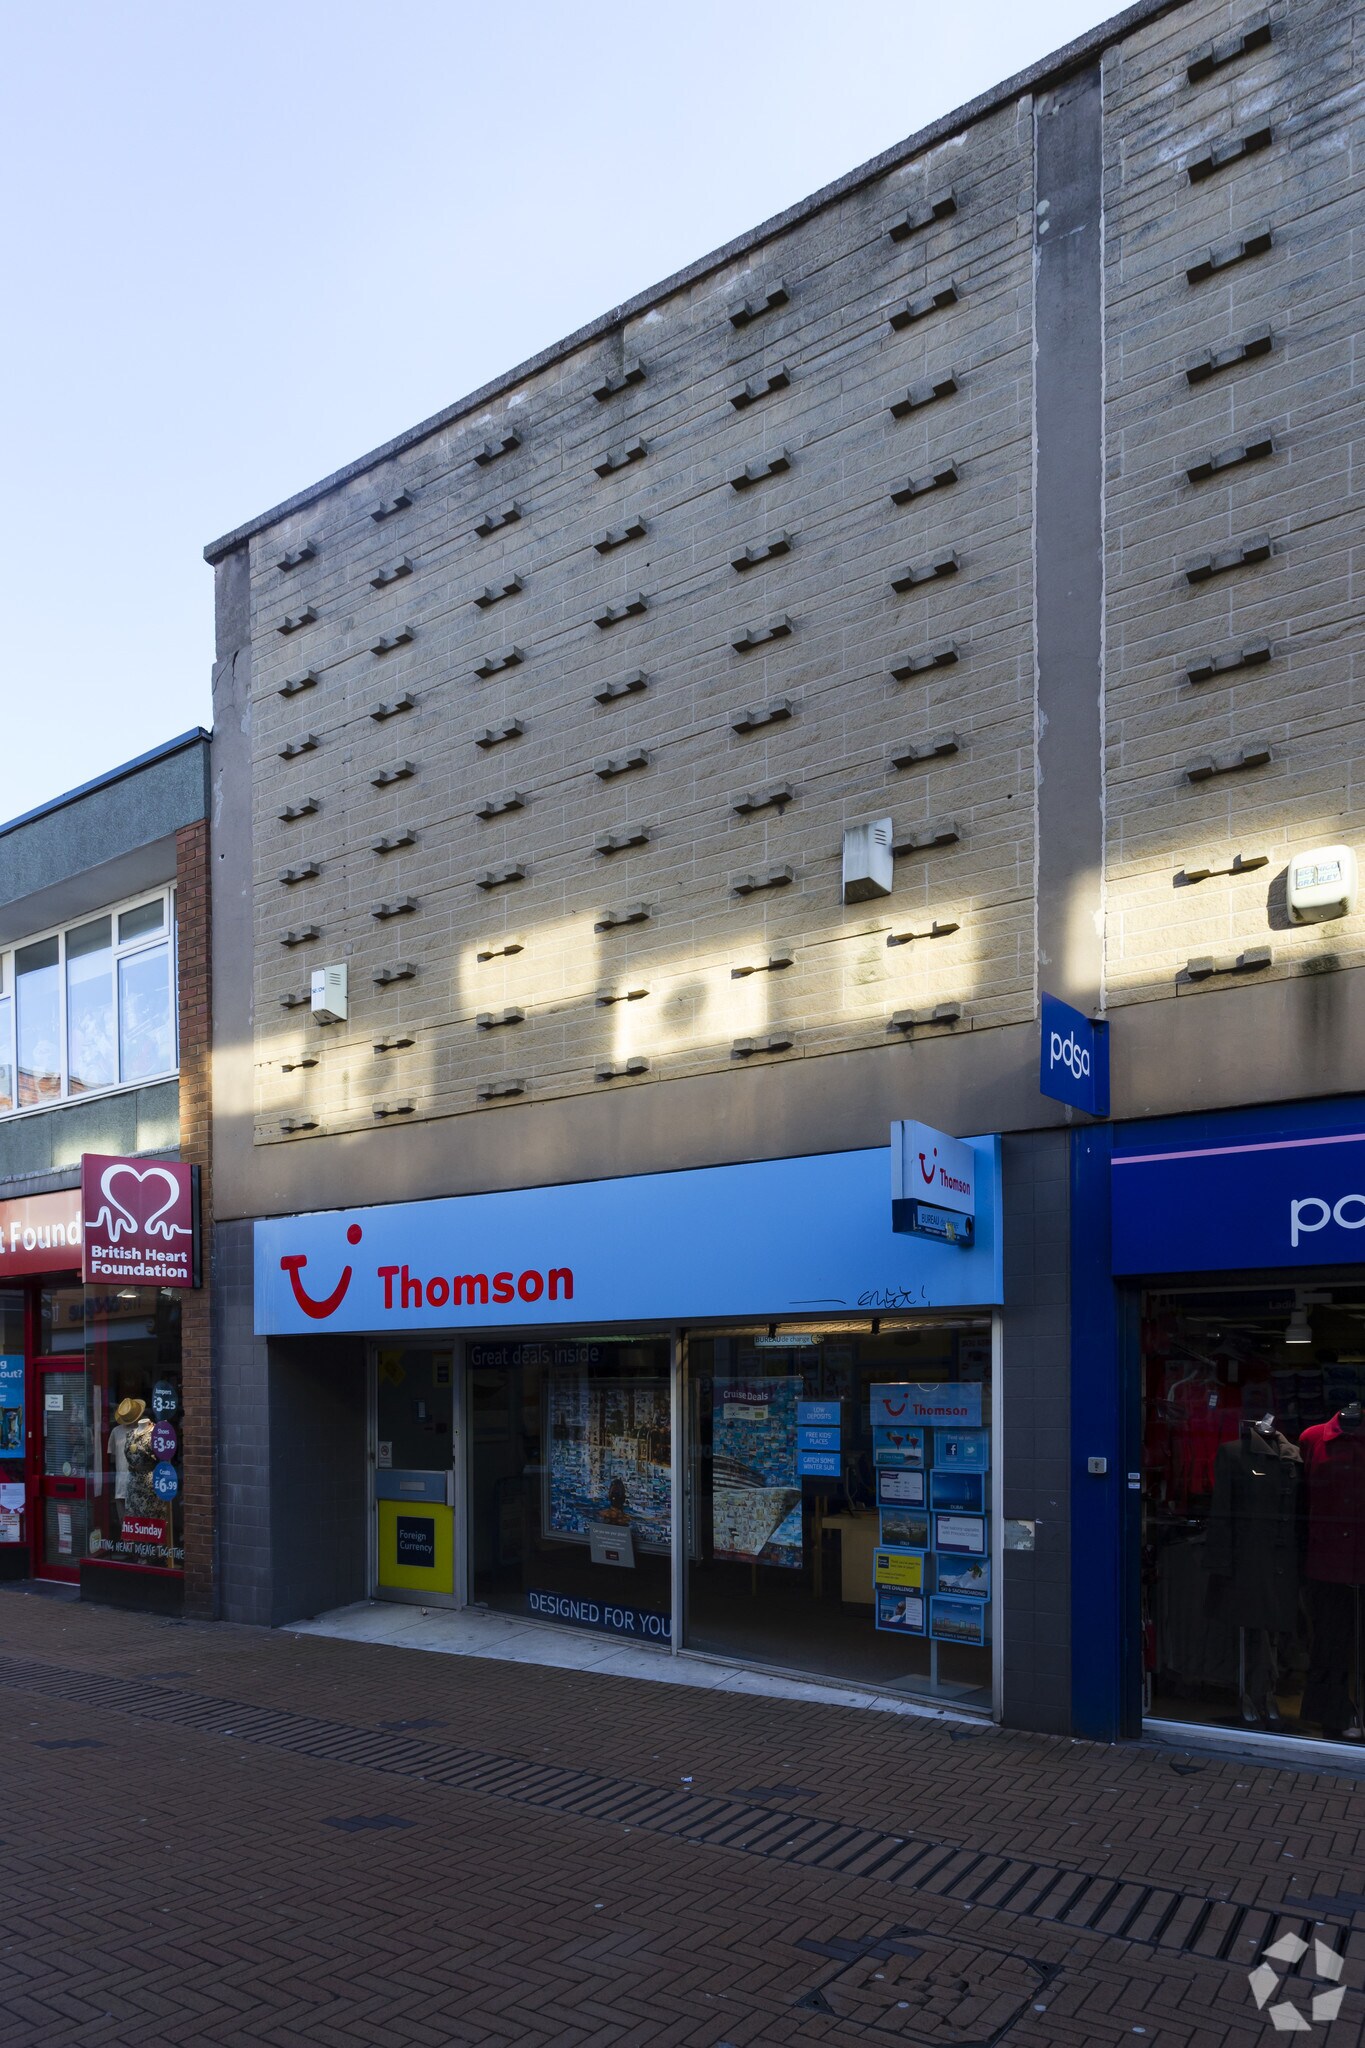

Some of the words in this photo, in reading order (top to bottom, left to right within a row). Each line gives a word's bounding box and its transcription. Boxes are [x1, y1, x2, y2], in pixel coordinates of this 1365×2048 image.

[1050, 1030, 1090, 1079] pdsa
[939, 1168, 971, 1196] Thomson
[921, 1213, 939, 1226] BUREAU
[91, 1245, 141, 1260] British
[145, 1248, 187, 1263] Heart
[91, 1261, 188, 1278] Foundation
[378, 1264, 574, 1310] Thomson
[790, 1336, 810, 1344] change
[471, 1345, 508, 1366] Great
[512, 1344, 550, 1366] deals
[553, 1344, 601, 1365] inside
[155, 1388, 172, 1396] Jumpers
[723, 1390, 747, 1400] Cruise
[747, 1392, 769, 1401] Deals
[153, 1397, 176, 1412] £3.25
[912, 1404, 968, 1416] Thomson
[153, 1437, 176, 1452] £3.99
[154, 1477, 177, 1492] £6.99
[134, 1522, 163, 1539] Sunday
[400, 1529, 427, 1542] Foreign
[115, 1540, 135, 1553] HEART
[135, 1543, 156, 1557] DISEASE
[400, 1541, 433, 1555] Currency
[529, 1592, 600, 1623] DESIGNED
[604, 1606, 635, 1631] FOR
[638, 1614, 672, 1638] YOU
